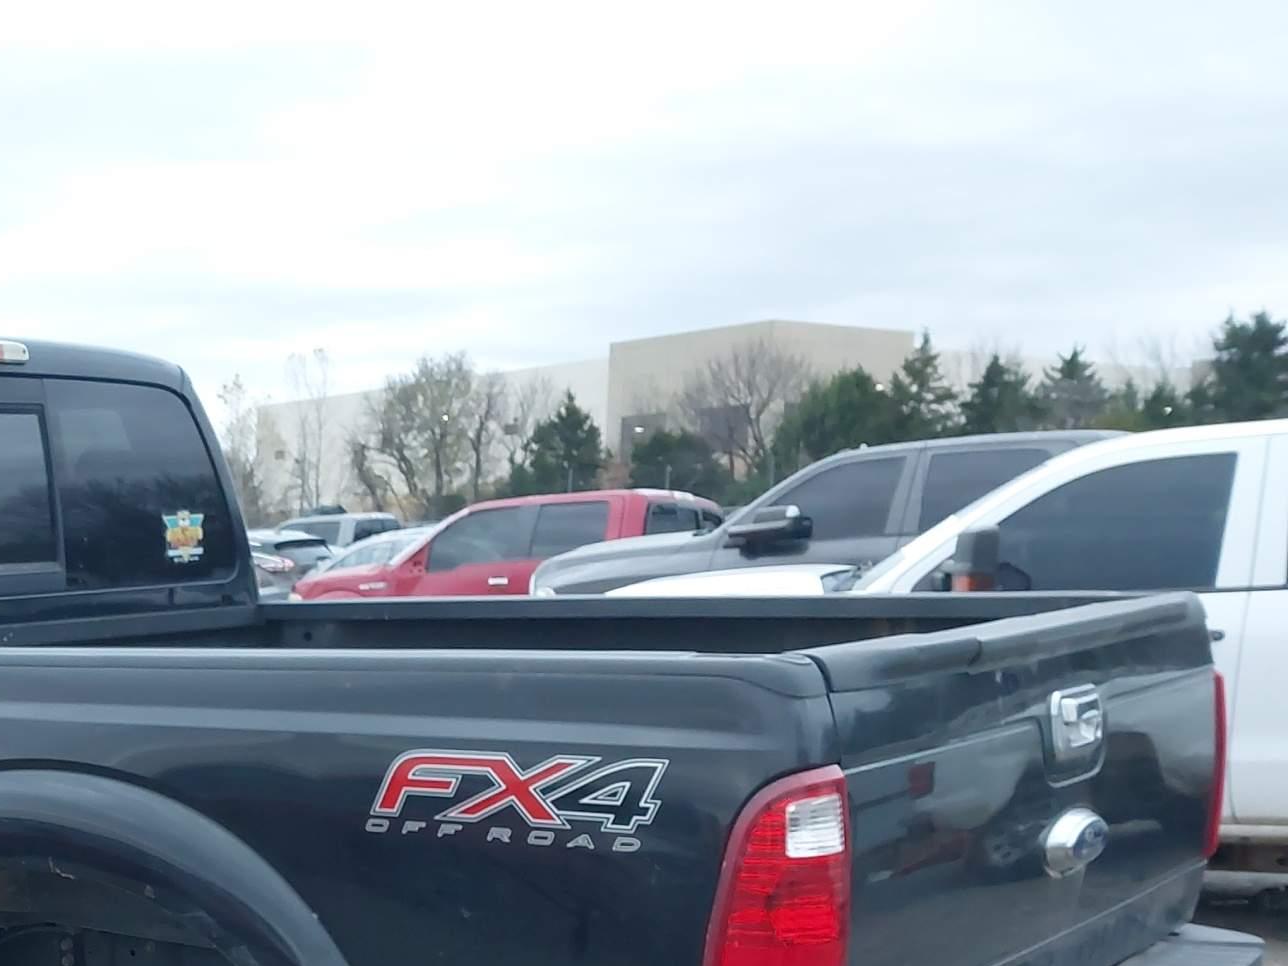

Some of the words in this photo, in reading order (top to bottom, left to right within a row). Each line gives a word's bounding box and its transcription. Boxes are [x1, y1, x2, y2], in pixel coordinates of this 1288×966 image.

[369, 747, 670, 834] FX4
[365, 817, 463, 839] OFF
[486, 826, 642, 853] ROAD
